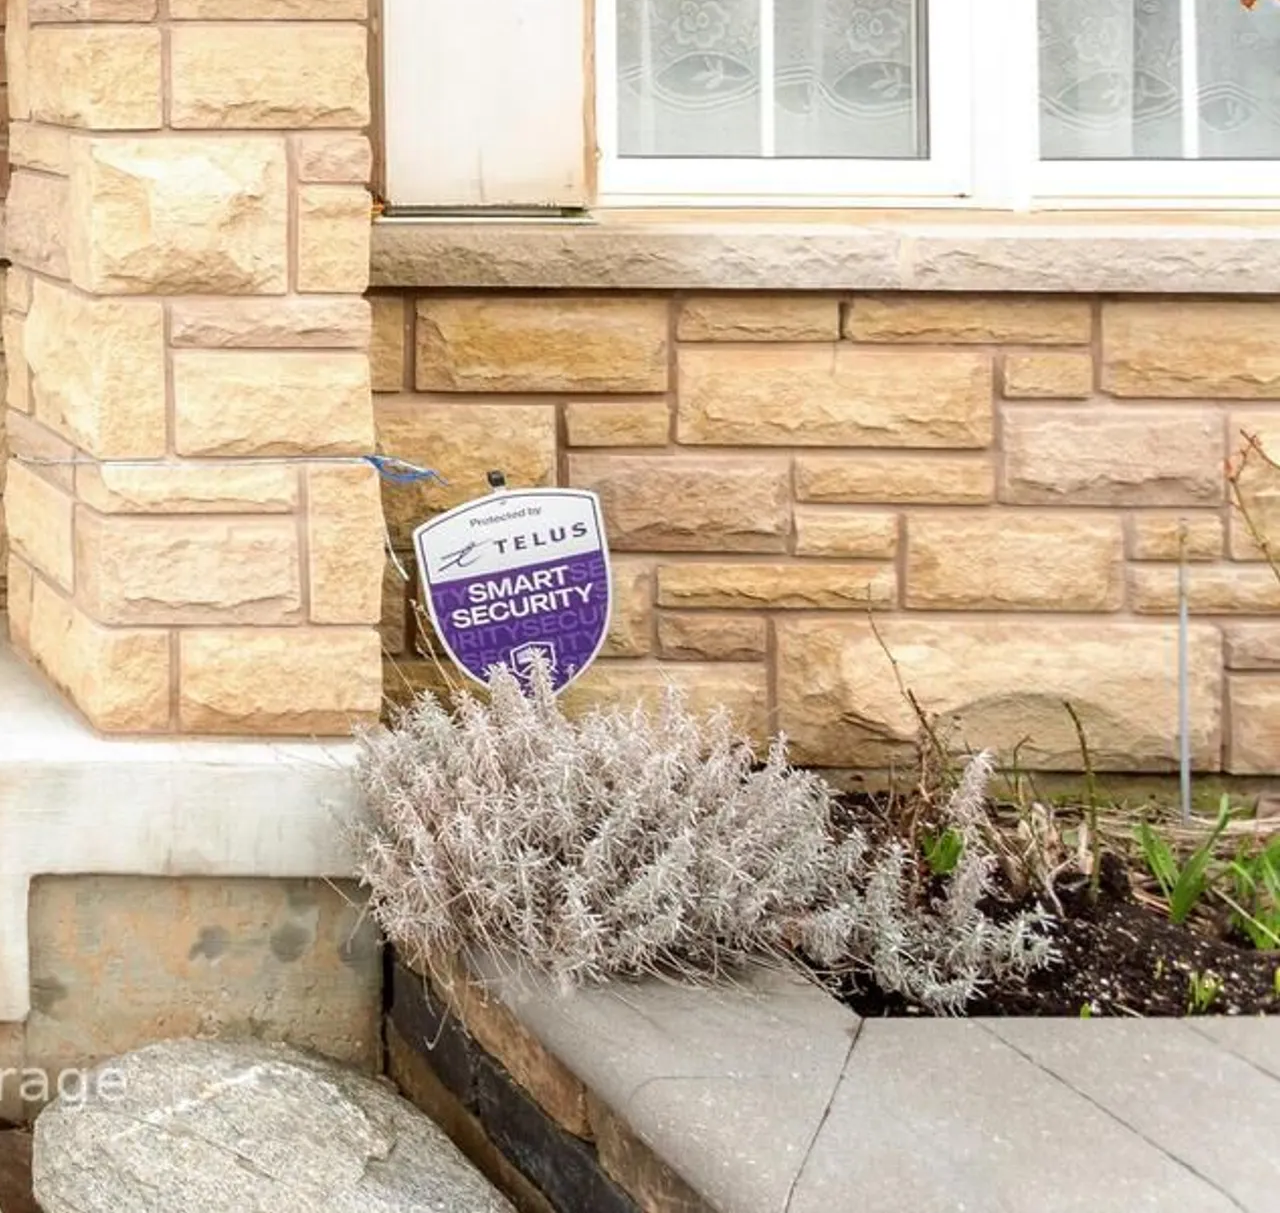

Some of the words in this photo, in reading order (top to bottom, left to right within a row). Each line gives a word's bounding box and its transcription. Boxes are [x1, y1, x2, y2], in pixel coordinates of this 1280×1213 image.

[469, 508, 525, 527] Protected
[527, 506, 542, 516] by
[493, 522, 588, 554] TELUS
[468, 565, 569, 603] SMART
[452, 583, 592, 628] SECURITY
